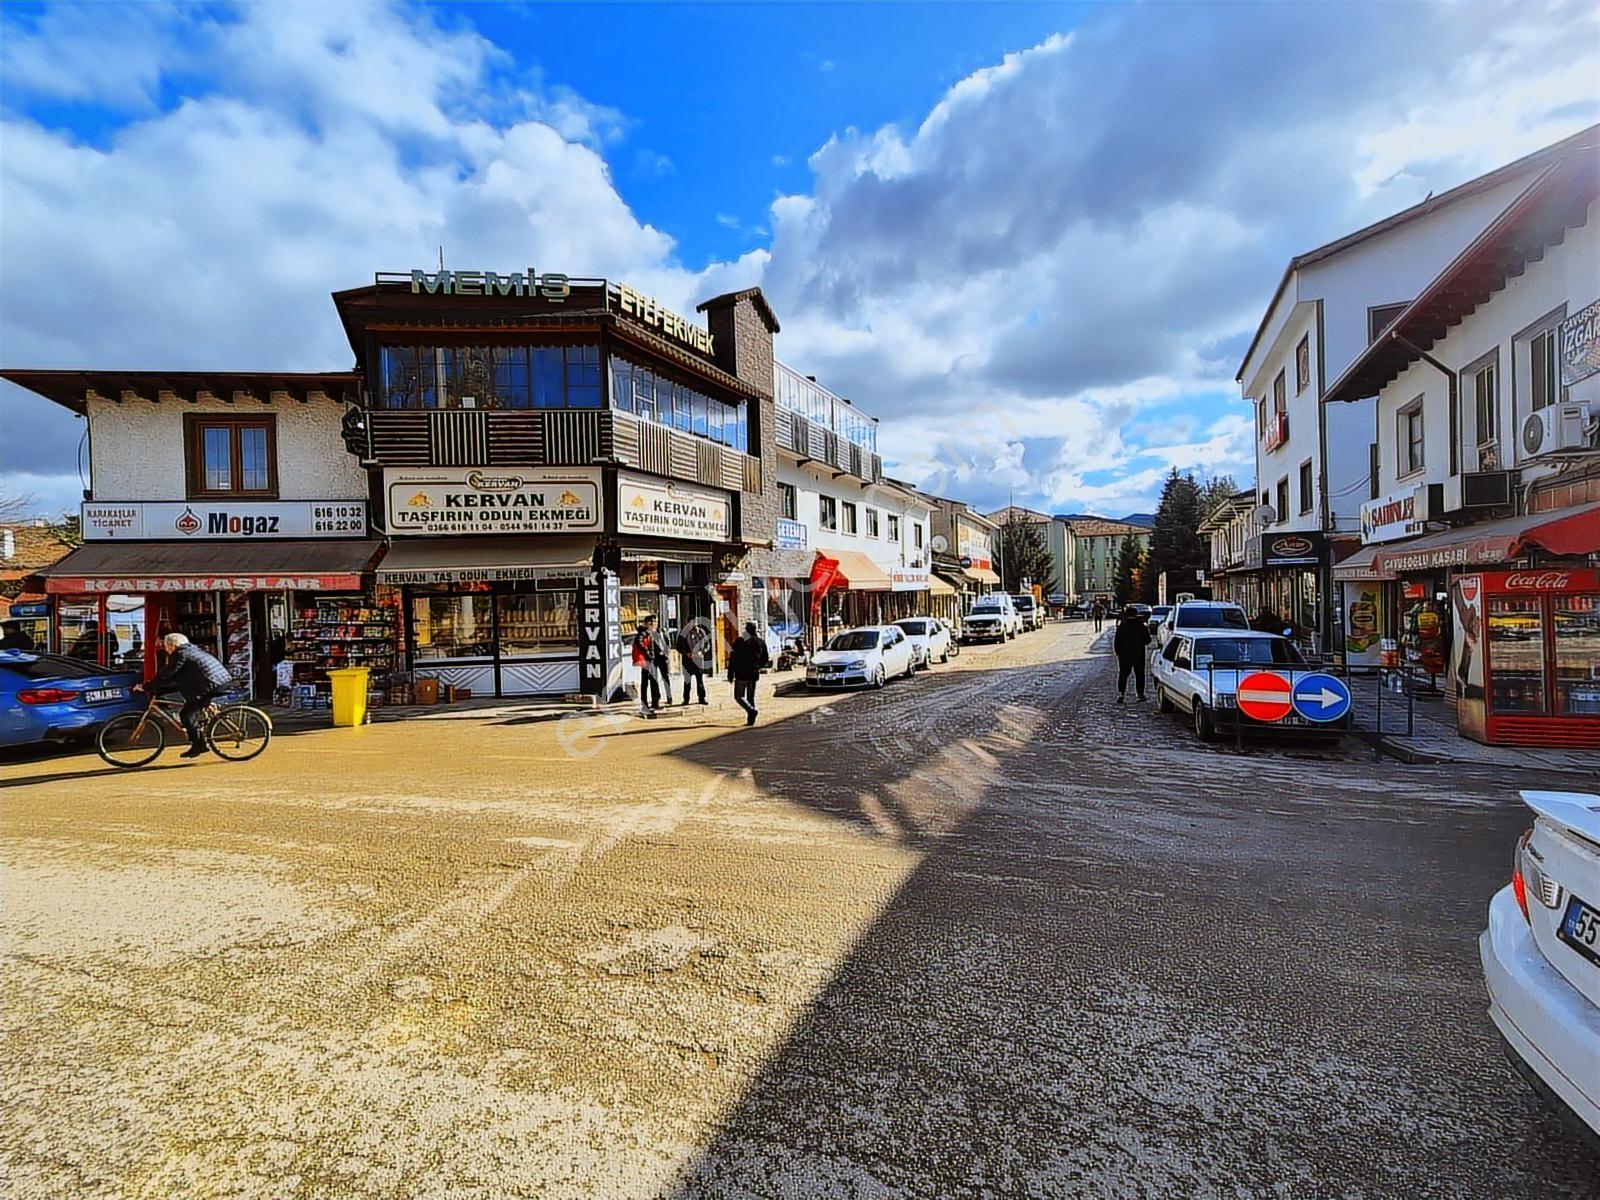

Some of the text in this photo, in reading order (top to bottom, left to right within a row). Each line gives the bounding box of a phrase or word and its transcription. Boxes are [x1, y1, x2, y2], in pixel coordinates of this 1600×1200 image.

[445, 493, 545, 508] KERVAN
[314, 507, 362, 519] 616 10 32
[398, 507, 590, 524] TAŞFIRIN ODUN EKMEĞİ
[653, 499, 706, 519] KERVAN
[208, 512, 279, 536] Mogaz
[314, 520, 362, 531] 616 22 00
[482, 523, 493, 531] 04
[500, 523, 520, 531] 0544
[523, 523, 538, 531] 961
[672, 516, 695, 529] ODUN
[384, 572, 426, 583] KERVAN
[1505, 572, 1569, 590] Coca-Cola
[584, 571, 602, 679] KERVAN
